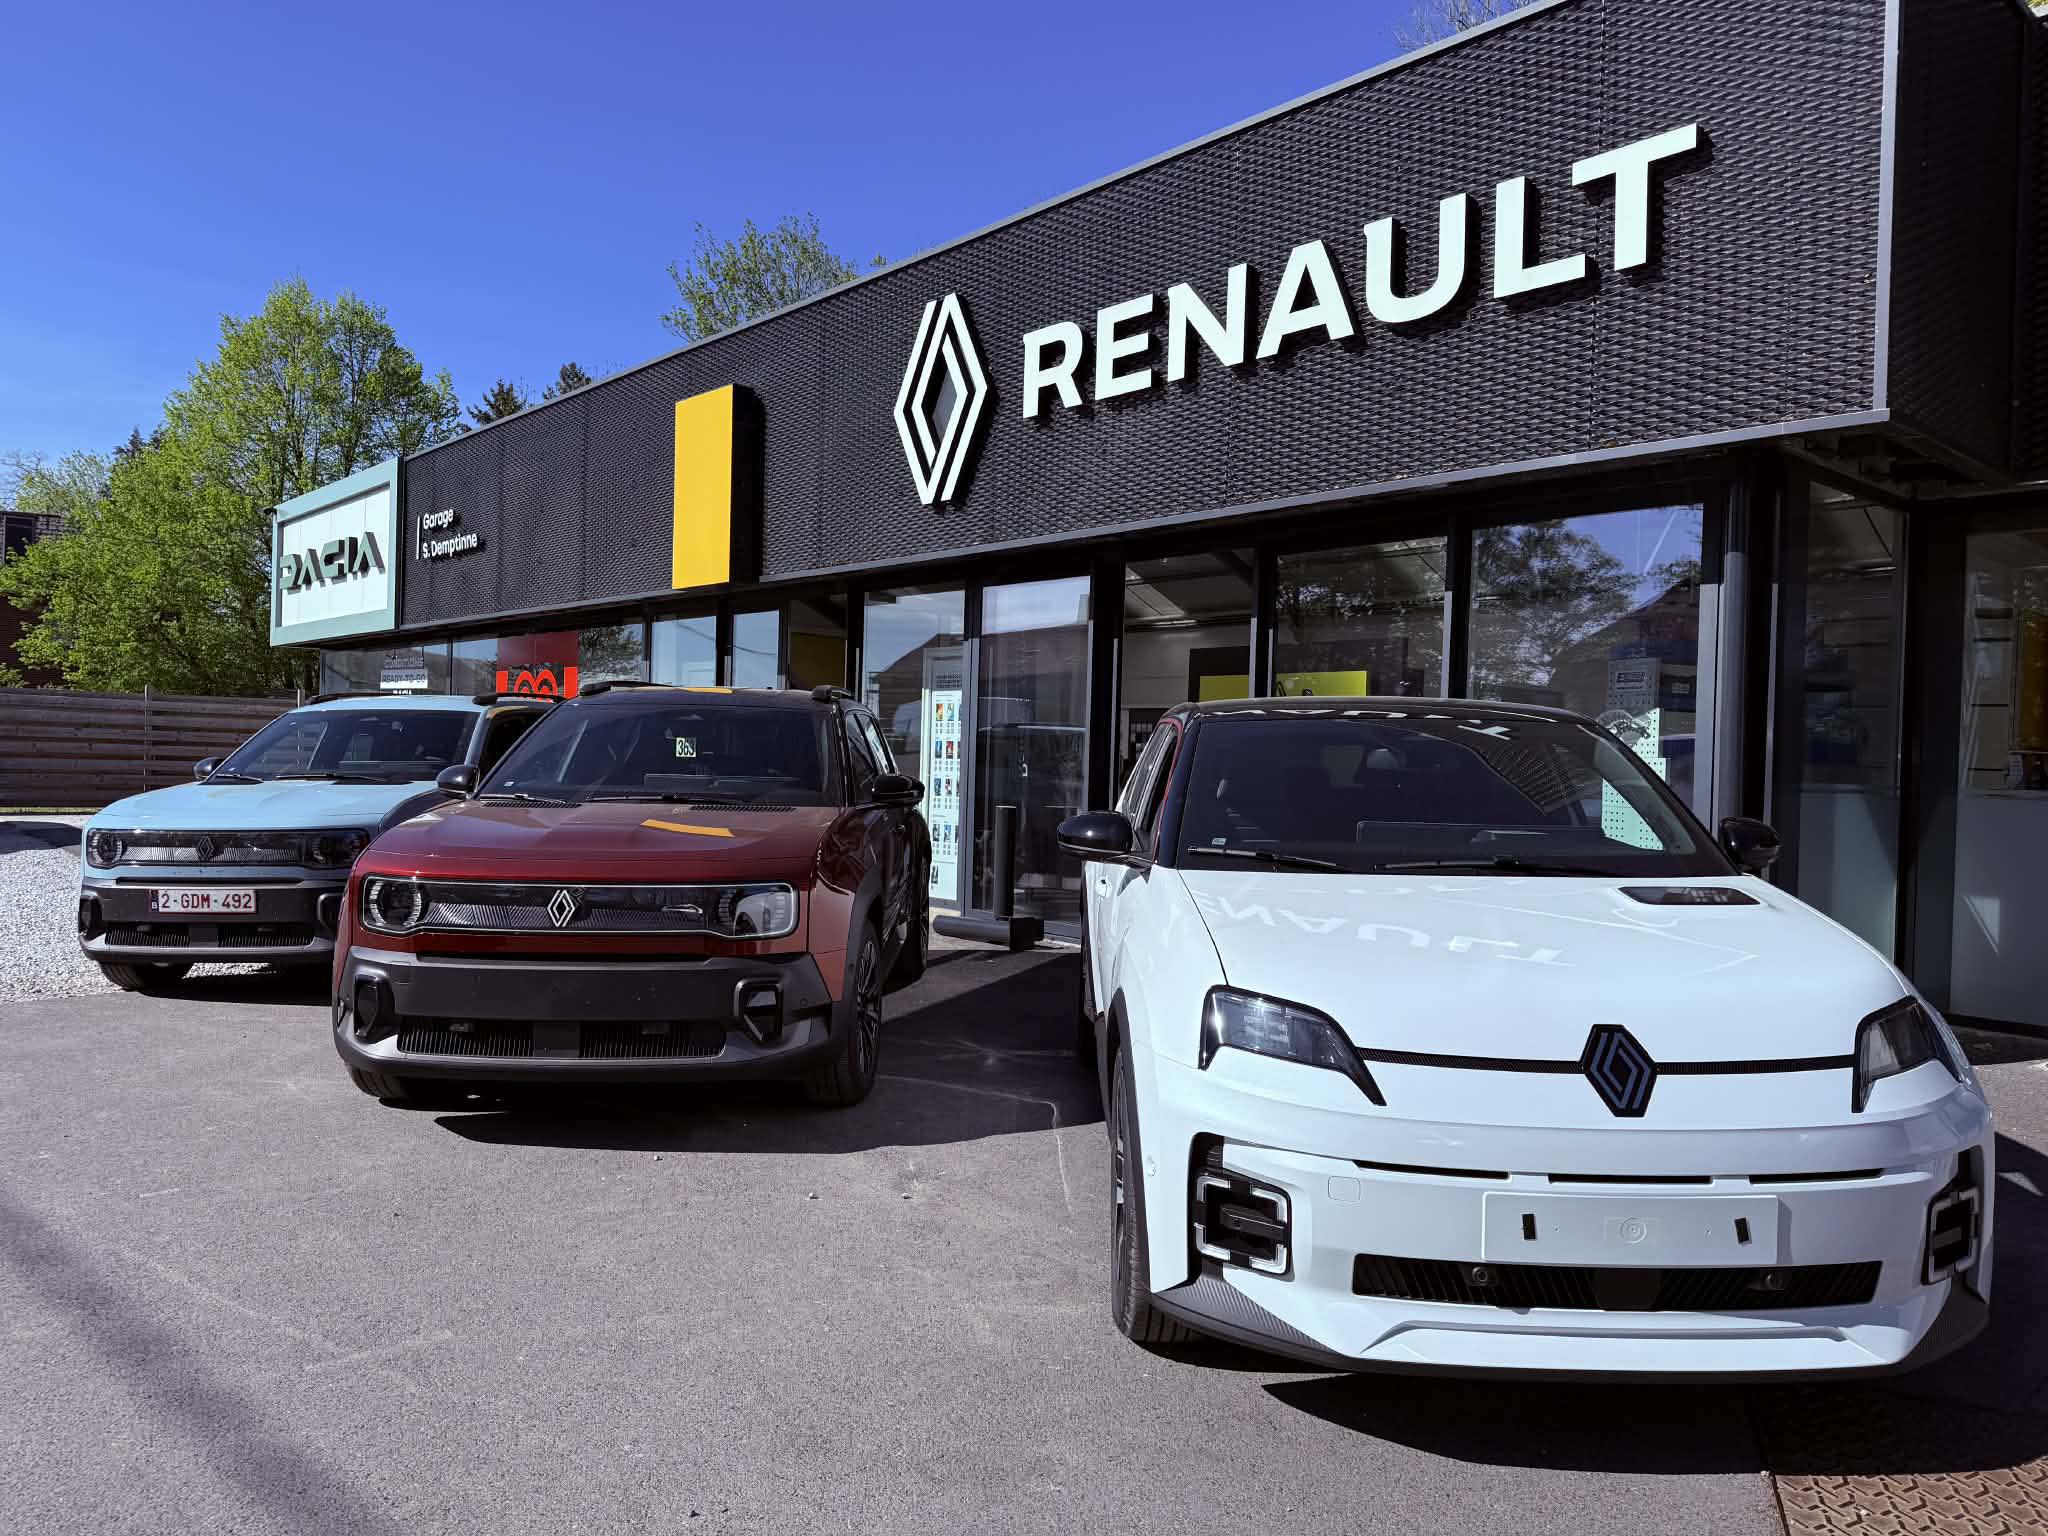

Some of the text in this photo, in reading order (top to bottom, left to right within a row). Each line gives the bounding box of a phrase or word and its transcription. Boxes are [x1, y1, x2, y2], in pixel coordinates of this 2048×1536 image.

[1022, 122, 1698, 419] RENAULT
[423, 507, 454, 530] Garage
[279, 531, 385, 594] DACIA
[422, 532, 478, 559] S. Demptinne
